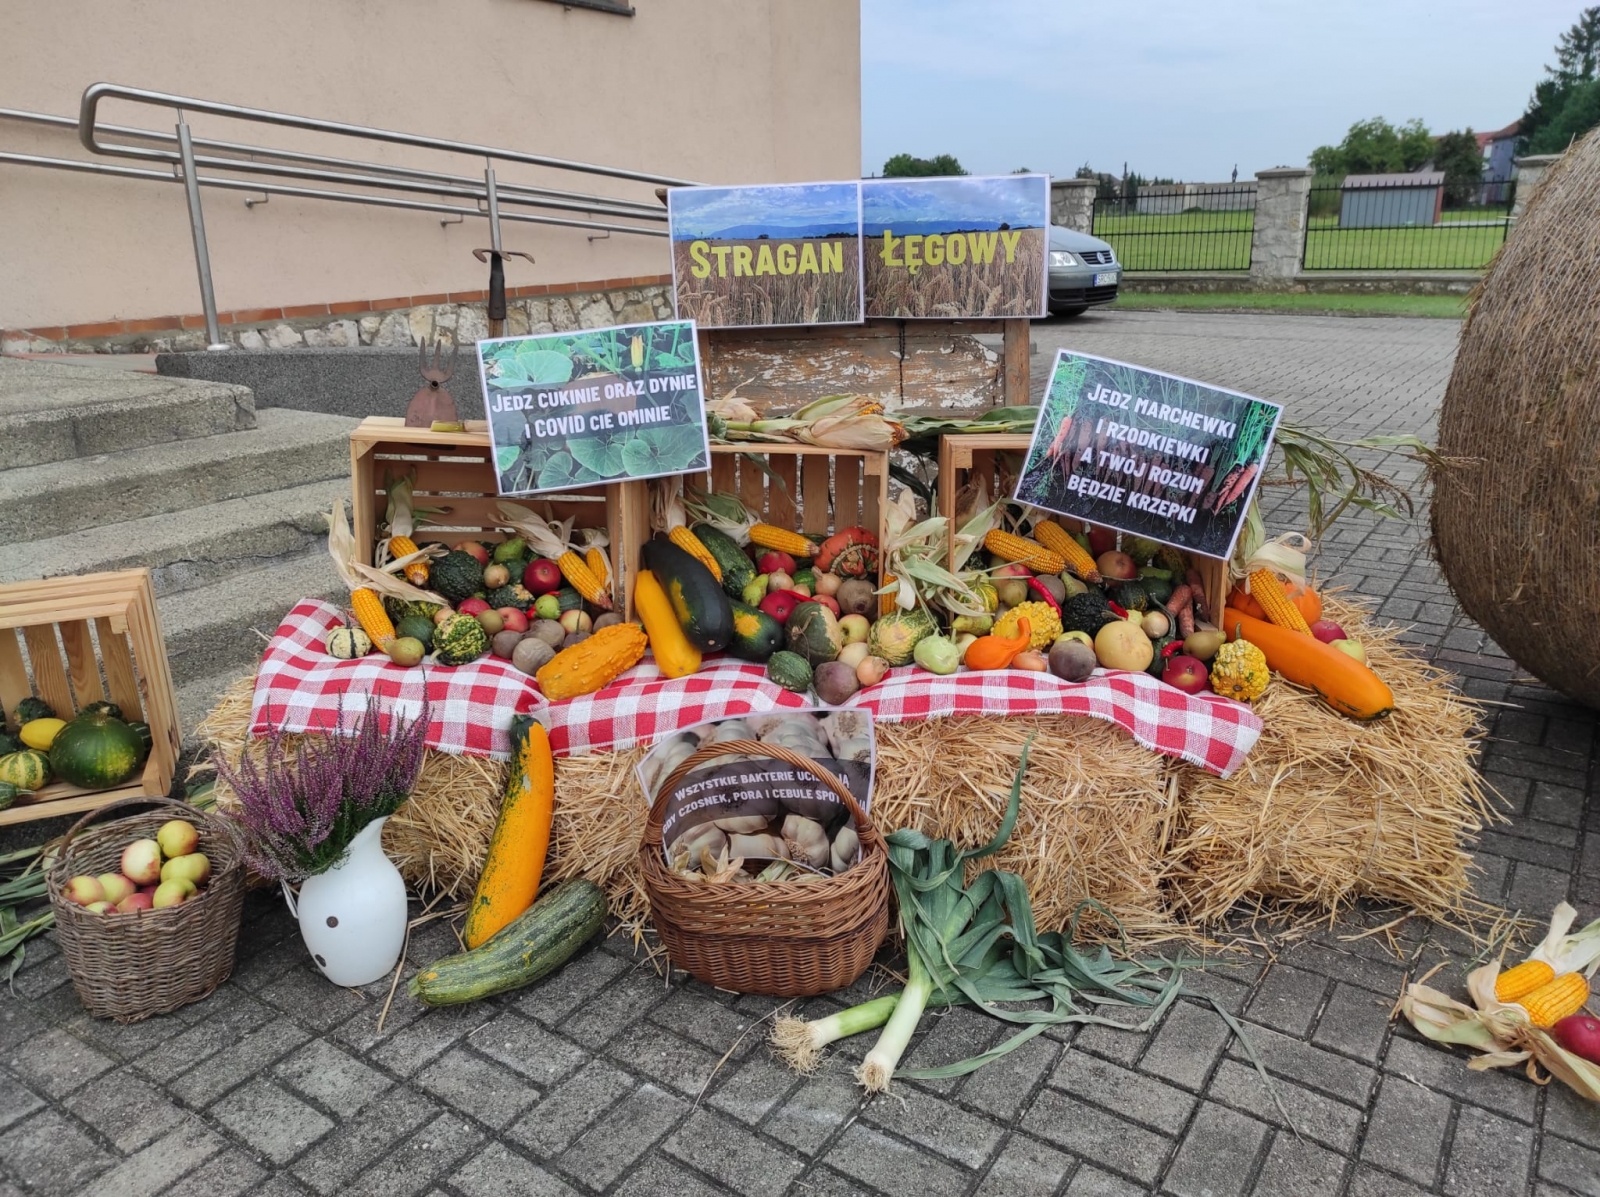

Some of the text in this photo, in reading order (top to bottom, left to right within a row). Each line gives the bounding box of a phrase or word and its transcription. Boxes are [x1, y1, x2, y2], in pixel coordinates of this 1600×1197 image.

[690, 229, 1022, 279] STRAGAN ŁĘGOWY
[492, 374, 697, 413] JEDZ CUKINIE ORAZ DYNIE
[1087, 383, 1237, 439] JEDZ MARCHEWKI
[525, 405, 671, 439] I COVID CIE OMINIE
[1096, 418, 1210, 464] I RZODKIEWKI
[1080, 447, 1205, 495] A TWÓJ ROZUM
[1067, 474, 1198, 524] BĘDZIE KRZEPKI
[674, 775, 739, 801] WSZYSTKIE
[740, 771, 795, 785] BAKTERIE
[662, 813, 676, 834] GDY
[678, 793, 731, 817] CZOSNEK,
[732, 789, 763, 801] PORA
[765, 789, 769, 799] I
[772, 789, 813, 800] CEBULE
